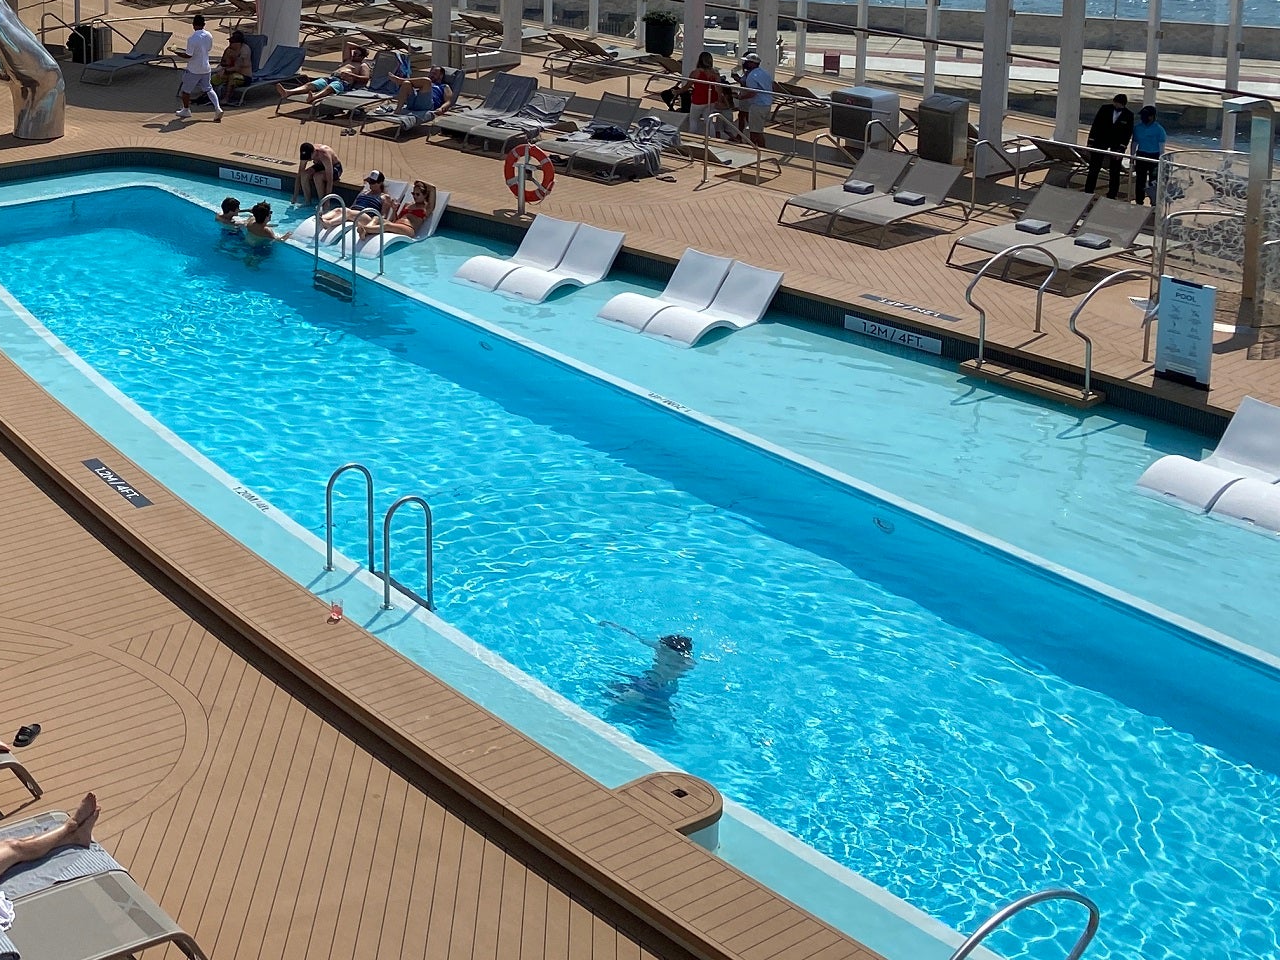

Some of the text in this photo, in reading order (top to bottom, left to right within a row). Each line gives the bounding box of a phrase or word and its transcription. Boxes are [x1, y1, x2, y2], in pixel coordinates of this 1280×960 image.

[1175, 291, 1197, 303] POOL
[862, 321, 888, 339] 1.2M
[898, 333, 924, 349] 4FT.
